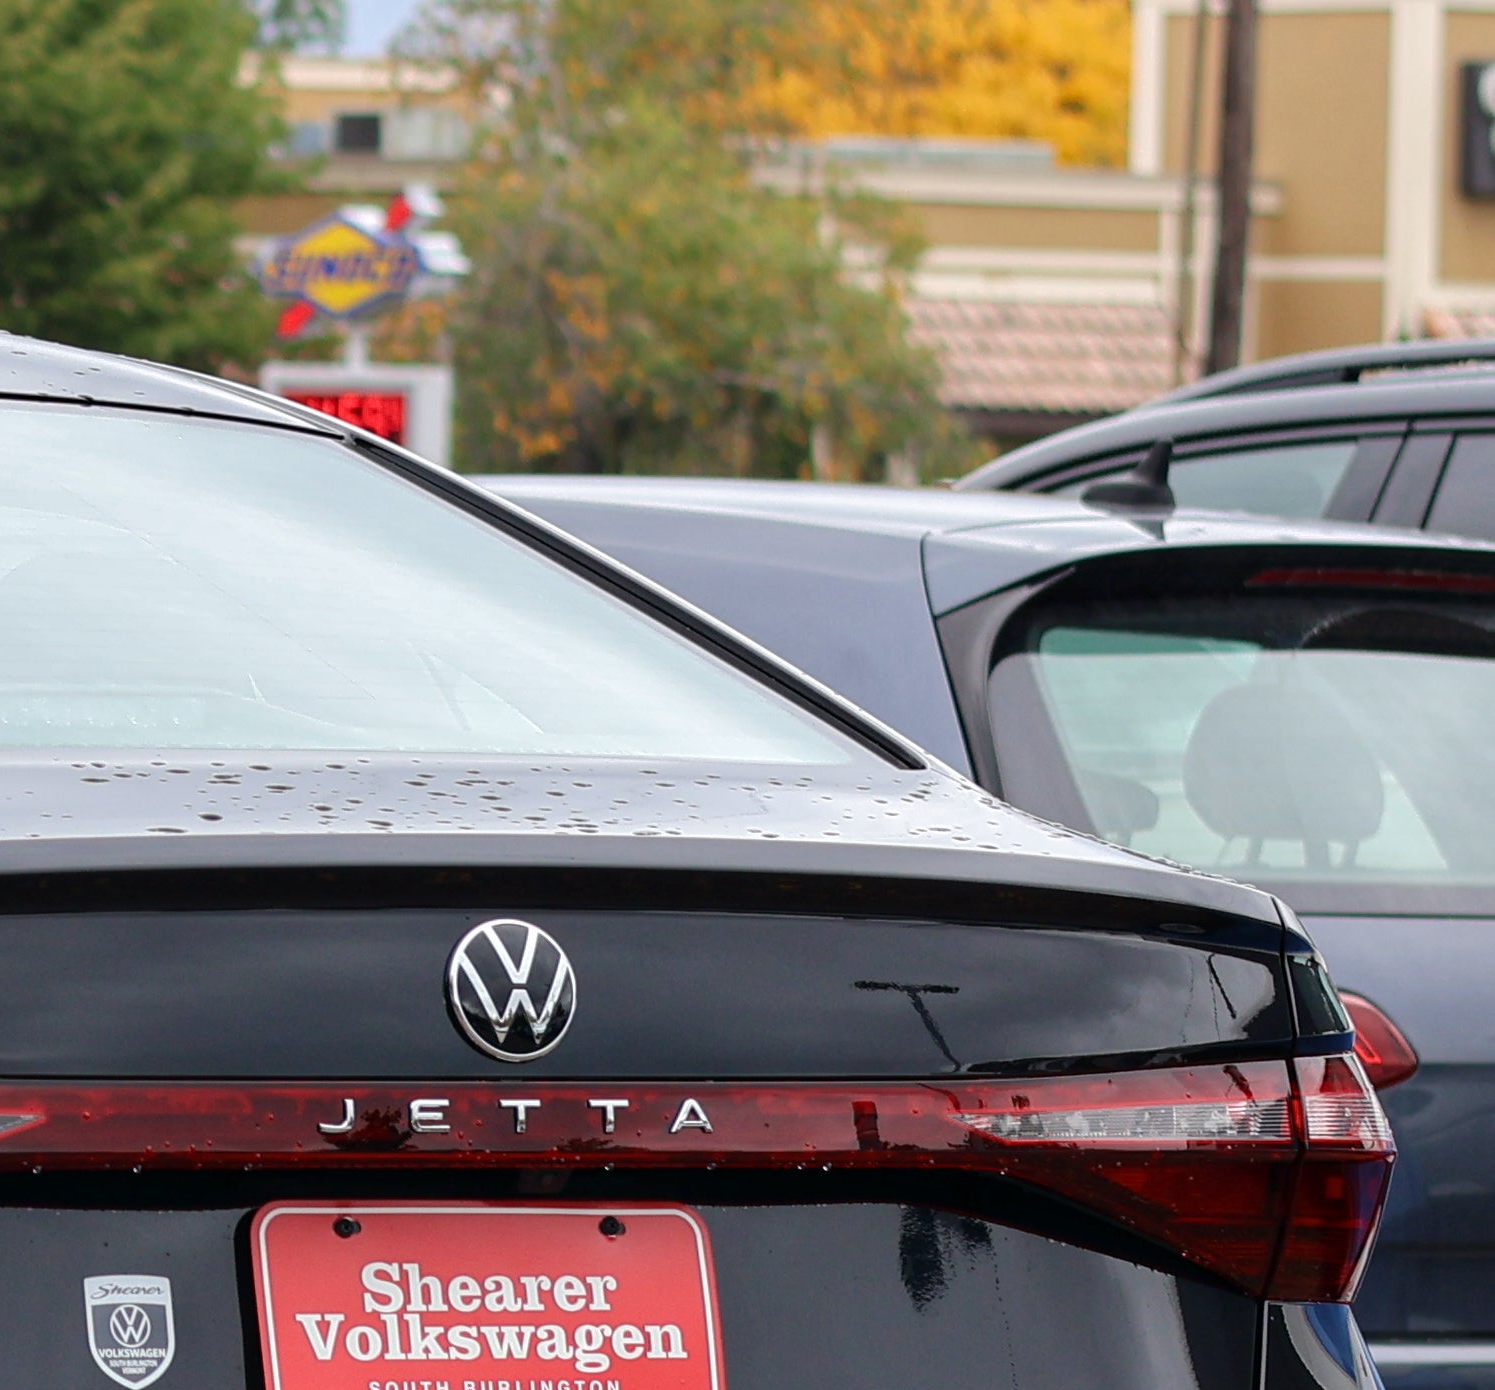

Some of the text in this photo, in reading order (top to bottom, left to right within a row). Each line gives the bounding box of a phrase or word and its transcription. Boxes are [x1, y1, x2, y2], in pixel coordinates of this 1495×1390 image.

[318, 1098, 714, 1134] JETTA
[361, 1262, 617, 1313] Shearer
[98, 1347, 166, 1359] VOLKSWAGEN
[295, 1313, 688, 1373] Volkswagen
